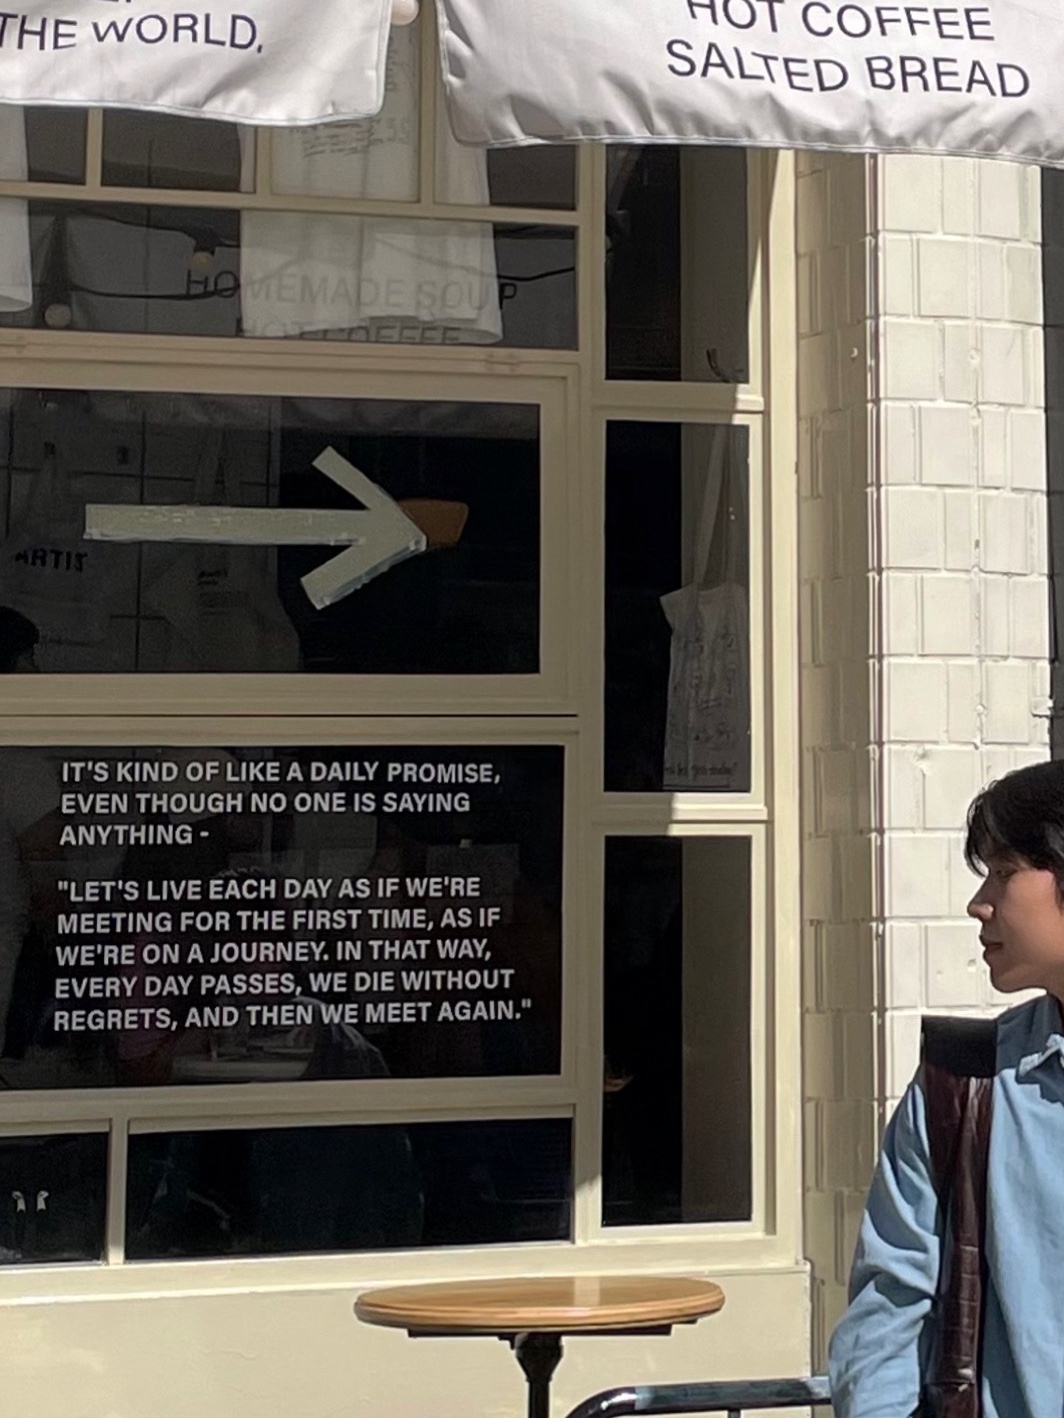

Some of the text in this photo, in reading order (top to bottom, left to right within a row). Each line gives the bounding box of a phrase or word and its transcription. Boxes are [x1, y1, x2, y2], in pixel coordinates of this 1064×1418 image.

[0, 12, 263, 53] THE WORLD,
[801, 1, 995, 41] COFFEE
[666, 39, 1030, 98] SALTED BREAD
[62, 761, 501, 784] IT'S KIND OF LIKE A DAILY PROMISE,
[61, 793, 470, 814] EVEN THOUGH NO ONE IS SAYING
[60, 825, 193, 846] ANYTHING
[58, 876, 480, 902] "LET'S LIVE EACH DAY AS IF WE'RE
[58, 908, 501, 934] MEETING FOR THE FIRST TIME, AS IF
[56, 938, 491, 965] WE'RE ON A JOURNEY. IN THAT WAY,
[55, 969, 515, 998] EVERY DAY PASSES, WE DIE WITHOUT
[54, 999, 531, 1031] REGRETS, AND THEN WE MEET AGAIN."
